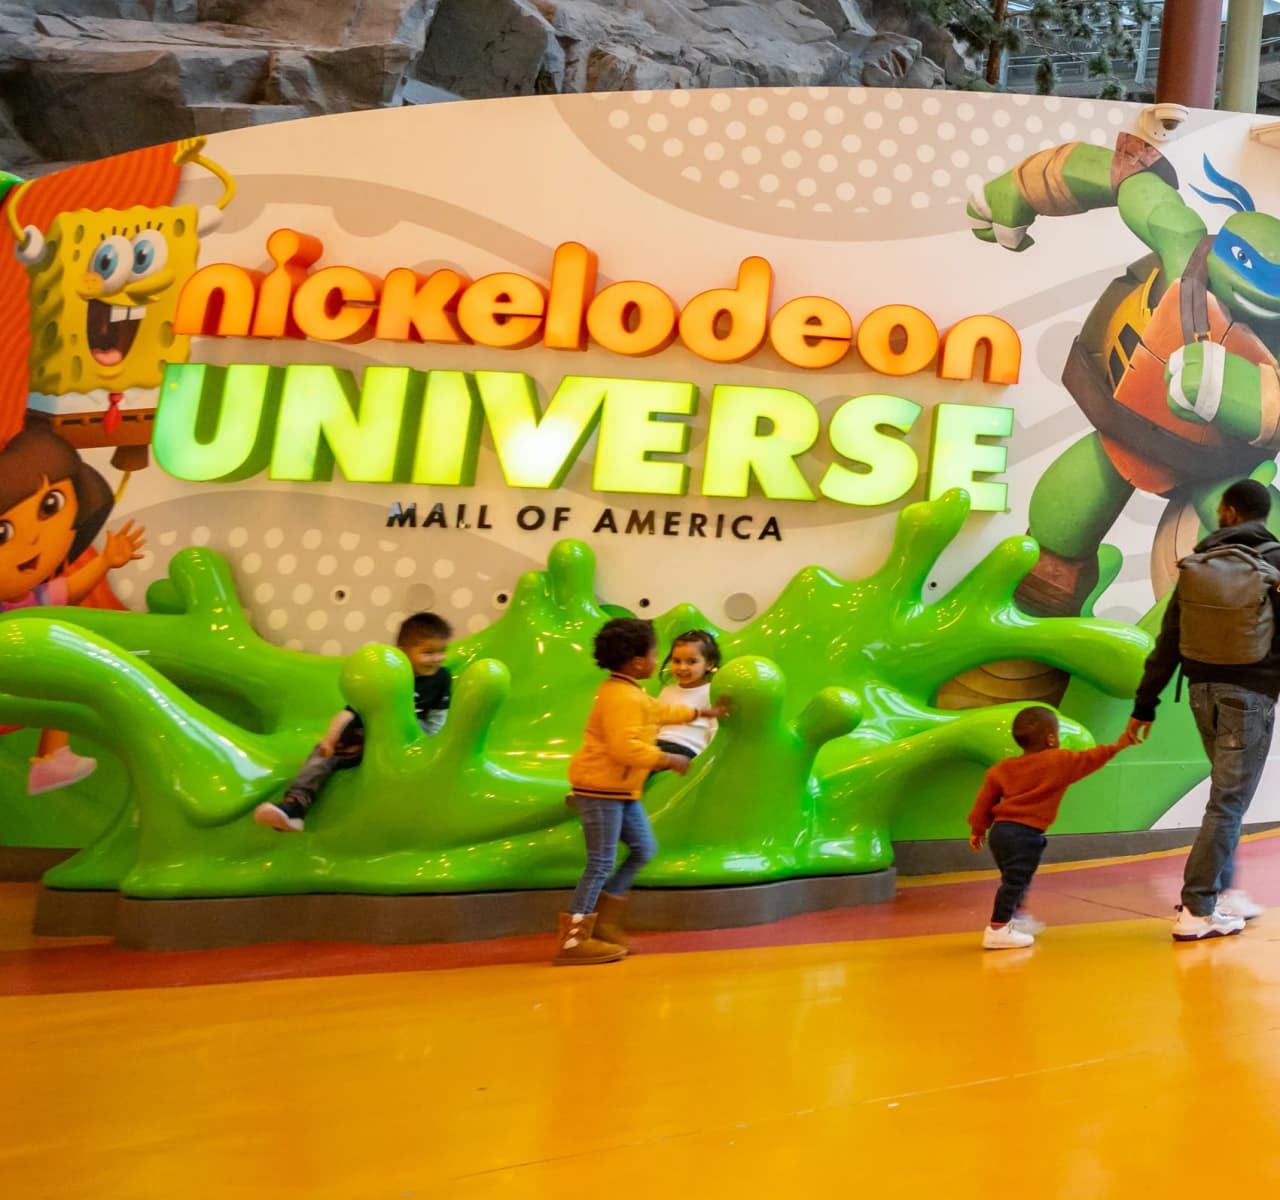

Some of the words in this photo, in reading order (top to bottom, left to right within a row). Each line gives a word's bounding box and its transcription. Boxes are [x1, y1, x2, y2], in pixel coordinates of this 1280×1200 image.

[173, 228, 1022, 385] nickelodeon
[152, 363, 1015, 513] UNIVERSE
[386, 502, 492, 529] MALL
[516, 504, 572, 531] OF
[593, 507, 783, 541] AMERICA
